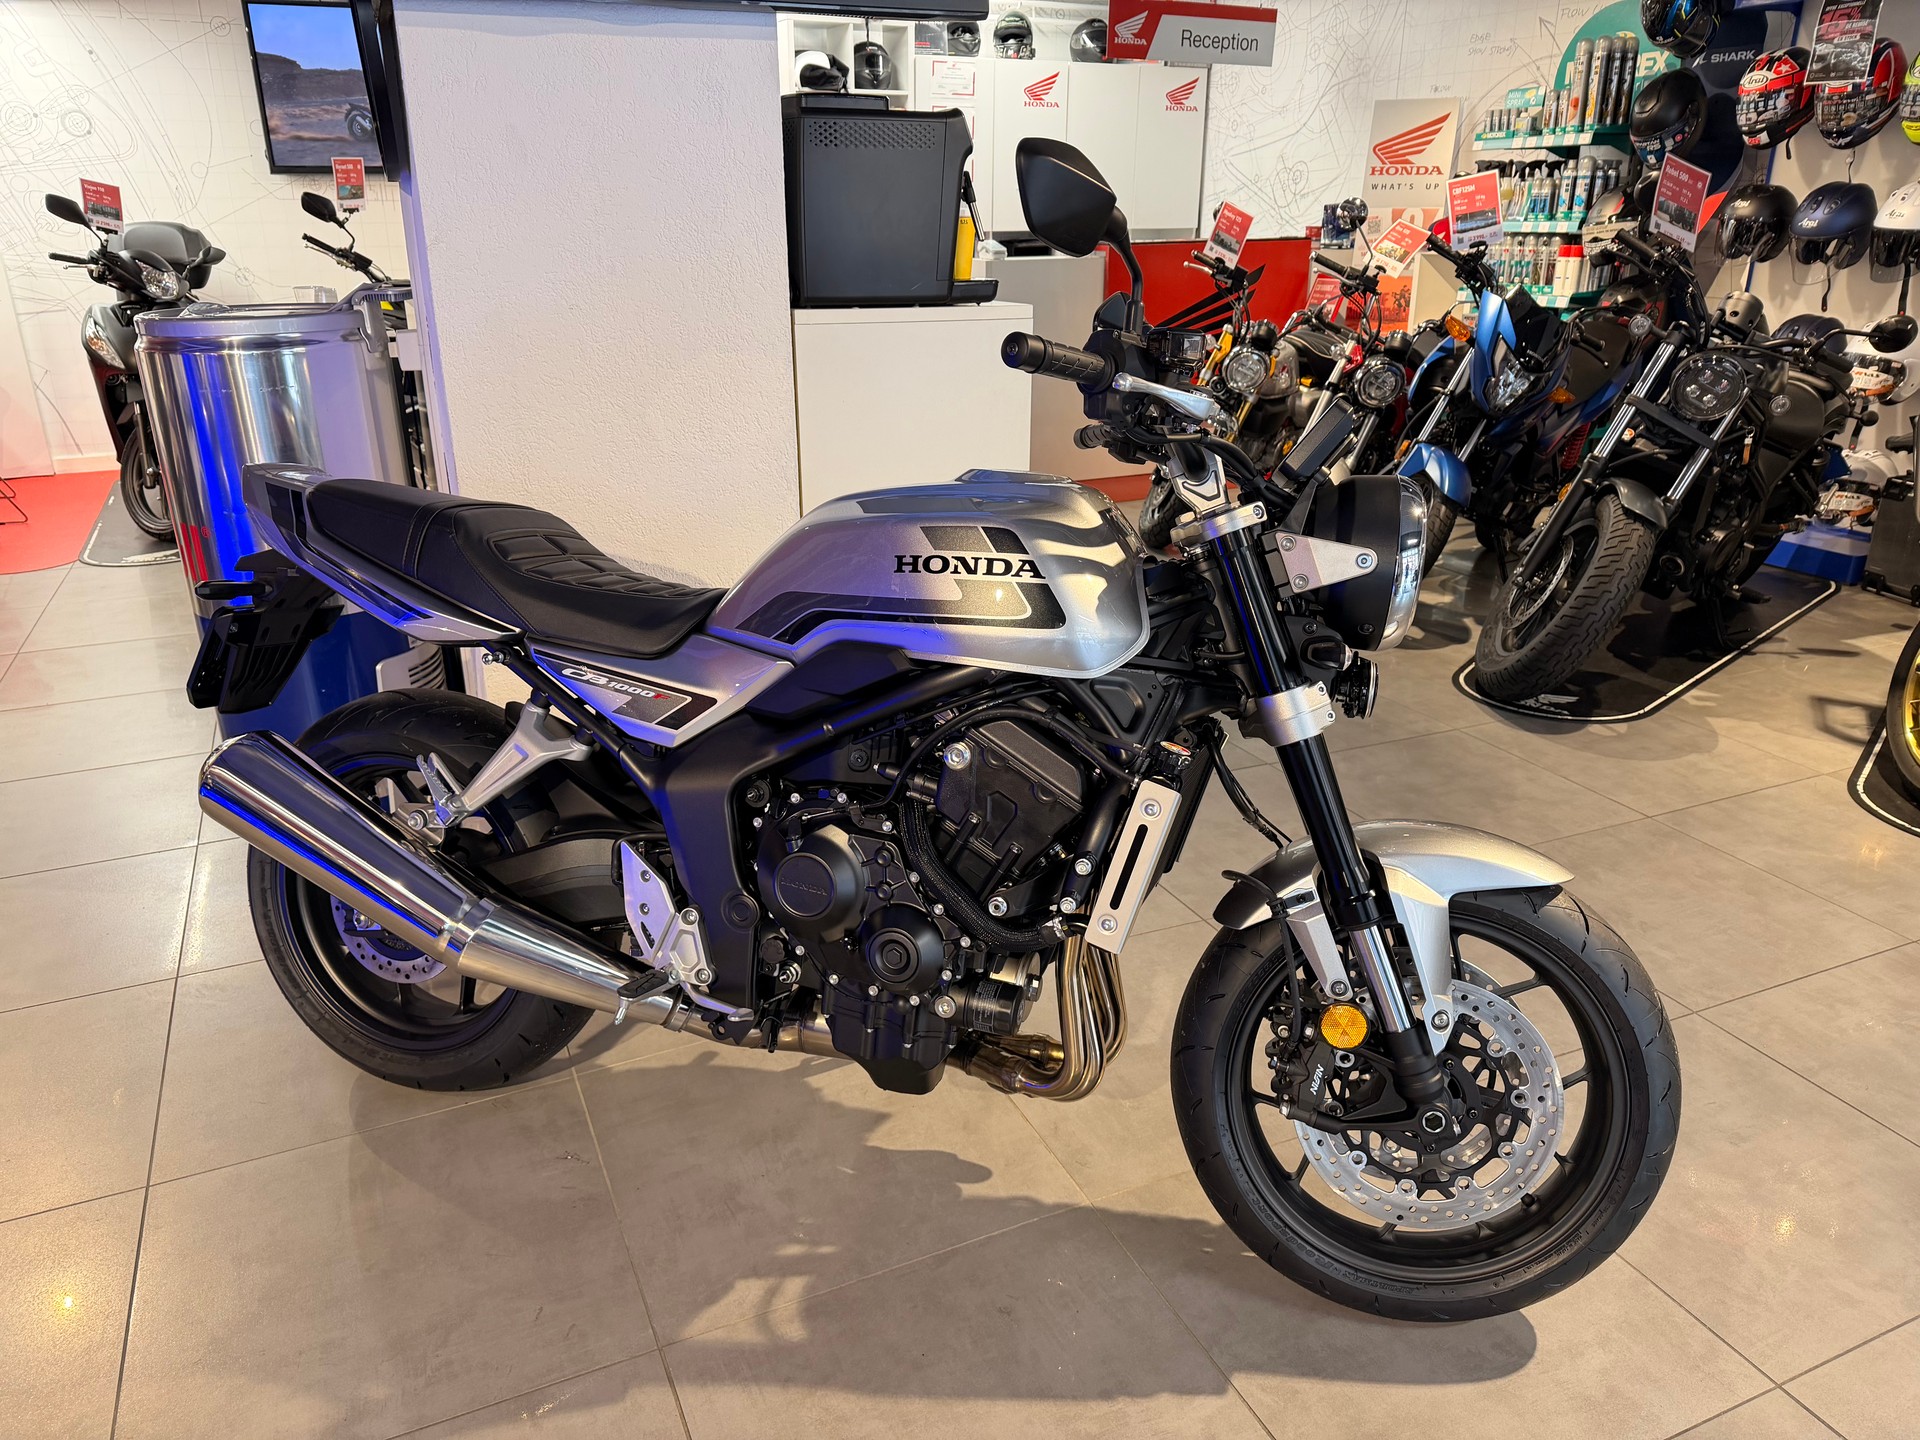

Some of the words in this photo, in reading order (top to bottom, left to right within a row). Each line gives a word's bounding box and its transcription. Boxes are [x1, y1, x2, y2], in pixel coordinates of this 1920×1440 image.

[1818, 6, 1862, 35] 15%
[1114, 37, 1148, 45] HONDA
[1181, 29, 1259, 54] Reception
[1711, 50, 1756, 63] SHARK
[1745, 75, 1766, 86] Arai
[1369, 165, 1444, 176] HONDA
[1665, 164, 1679, 178] Rebel
[1679, 171, 1689, 182] 500
[1452, 184, 1476, 195] CBF125M
[1731, 198, 1750, 208] Arai
[1885, 209, 1905, 218] Arai
[1798, 218, 1819, 227] Arai
[893, 554, 1047, 579] HONDA
[561, 668, 671, 701] CB1000F
[1309, 1063, 1325, 1095] NISSIN
